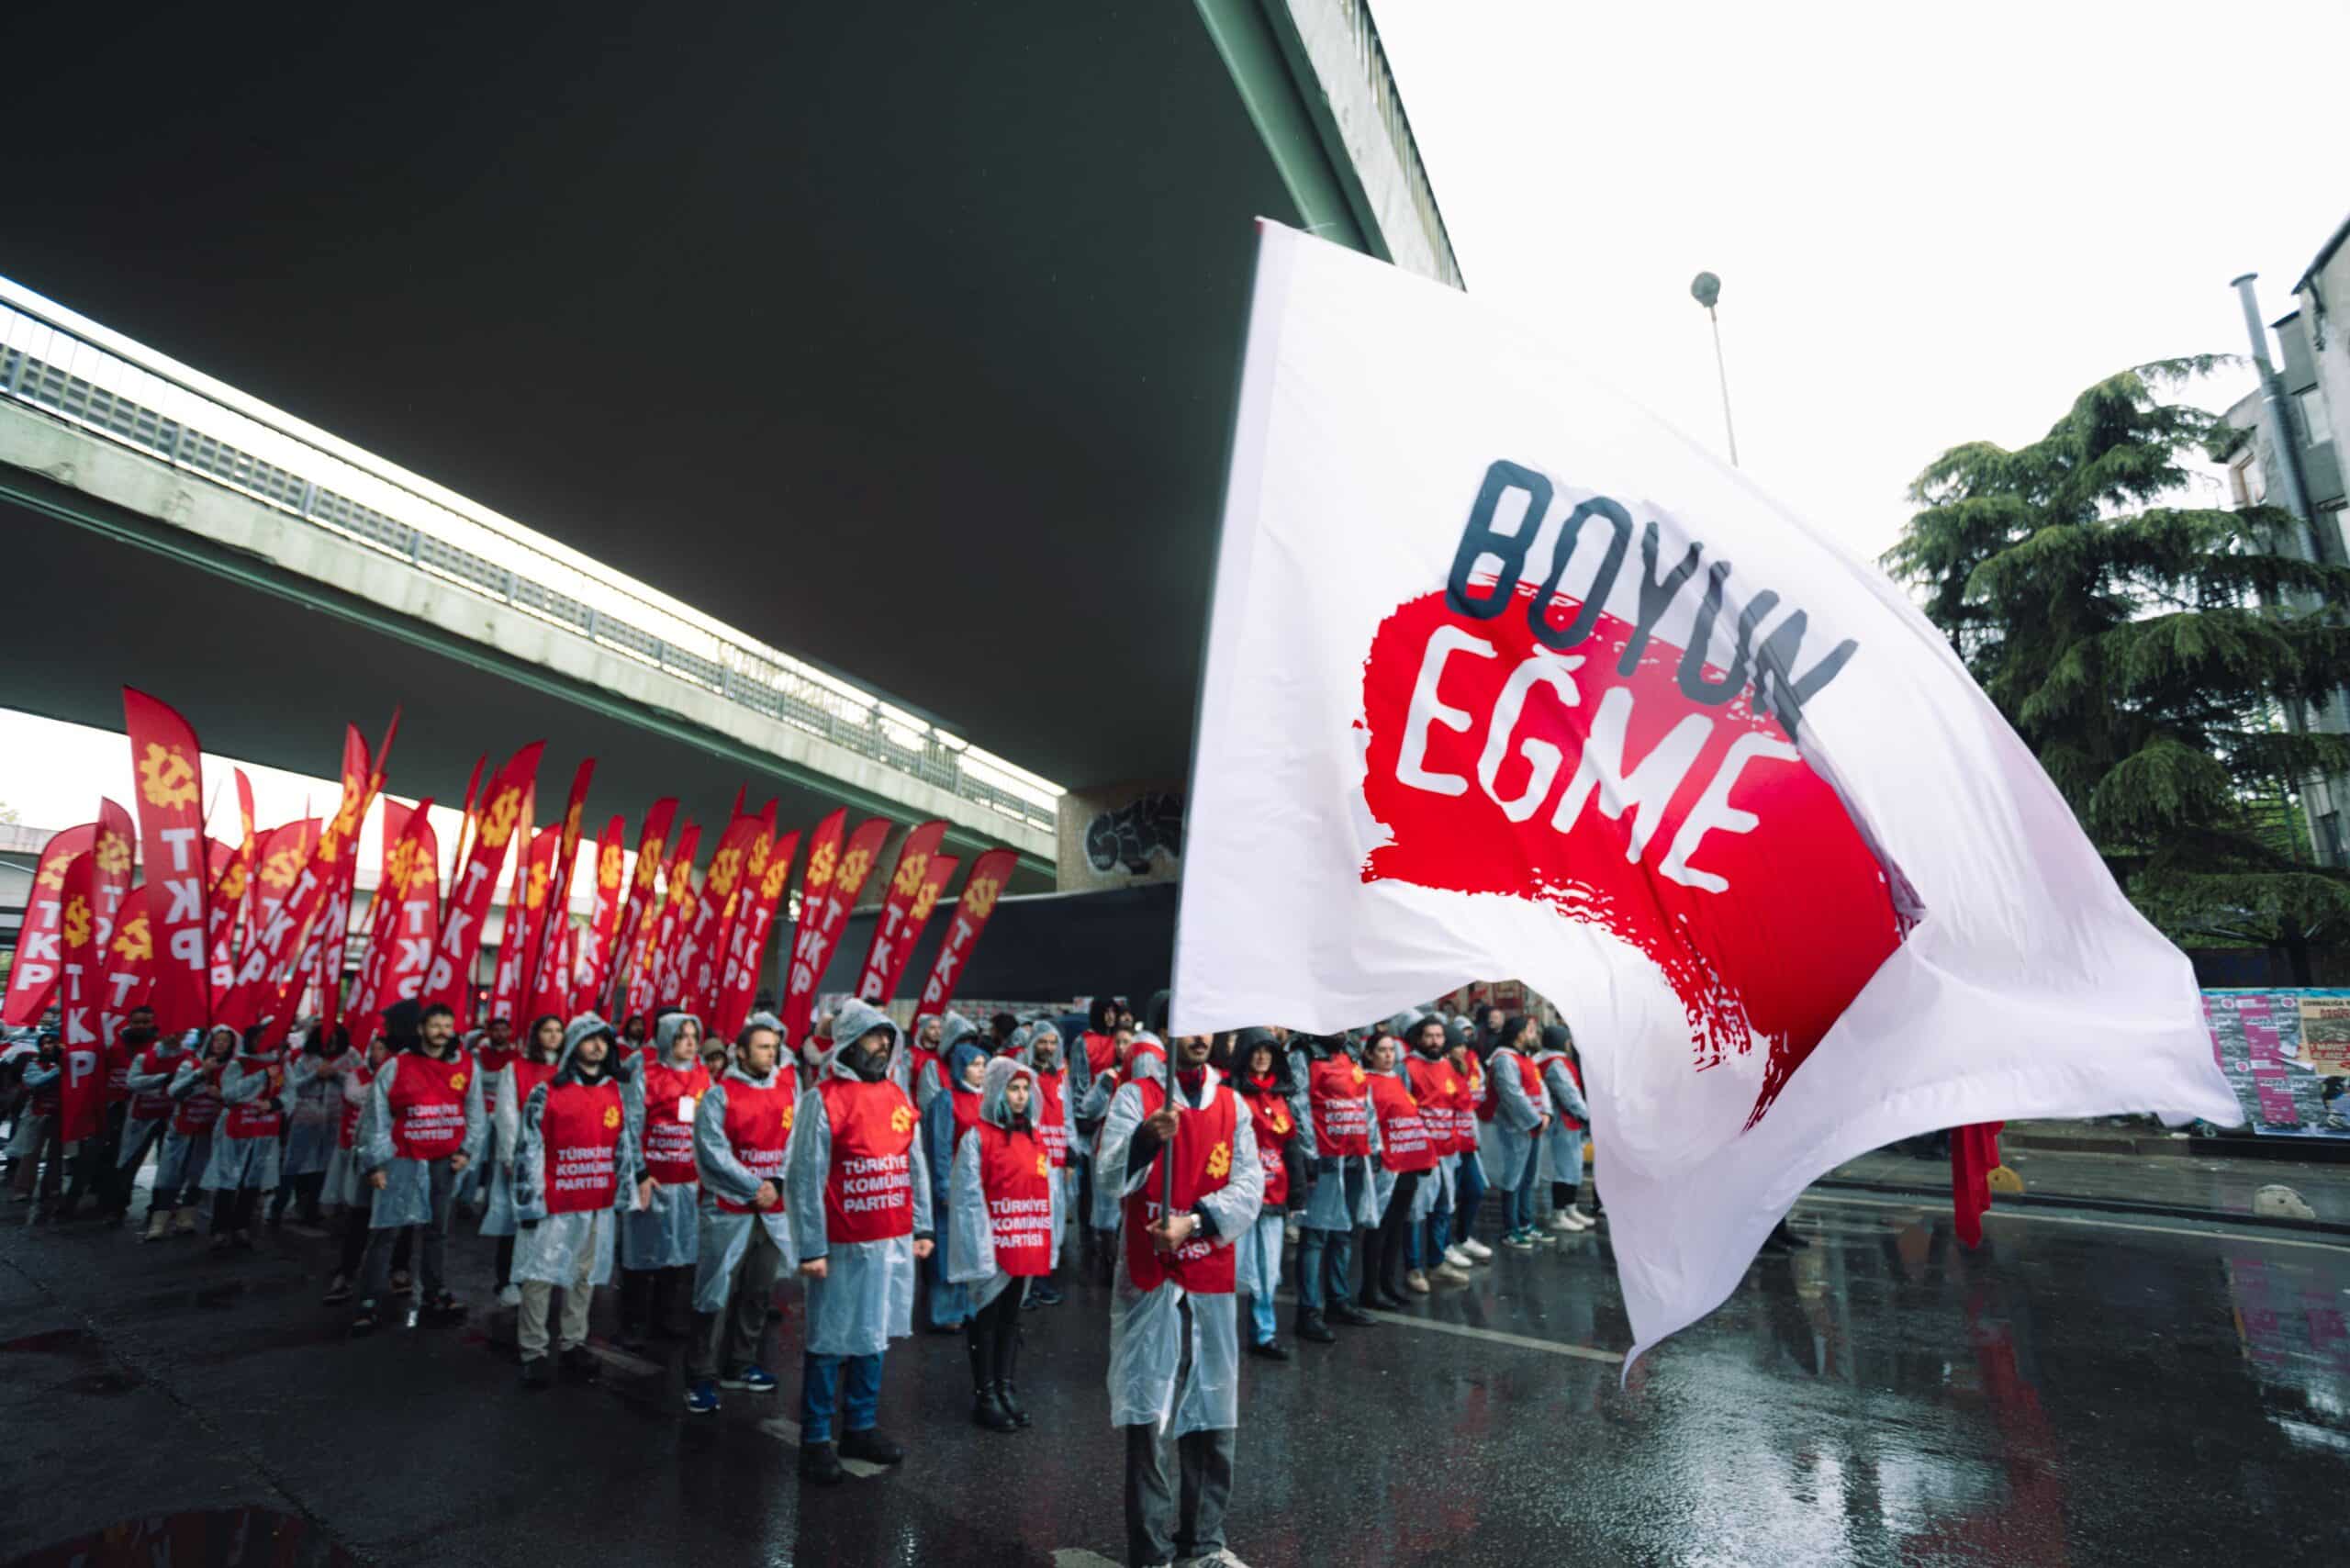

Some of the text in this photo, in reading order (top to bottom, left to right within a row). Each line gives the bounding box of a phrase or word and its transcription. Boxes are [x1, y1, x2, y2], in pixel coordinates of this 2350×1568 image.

[1446, 460, 1860, 743] BOYUN
[1395, 624, 1801, 894] EĞME
[15, 901, 62, 991] TKP
[422, 860, 488, 997] TKP
[791, 896, 843, 996] TKP
[860, 902, 904, 1000] TKP
[923, 918, 973, 1003] TKP
[65, 964, 96, 1089] TKP
[843, 1190, 905, 1214] PARTİSİ
[990, 1196, 1048, 1215] TÜRKİYE
[991, 1230, 1044, 1249] PARTİSİ
